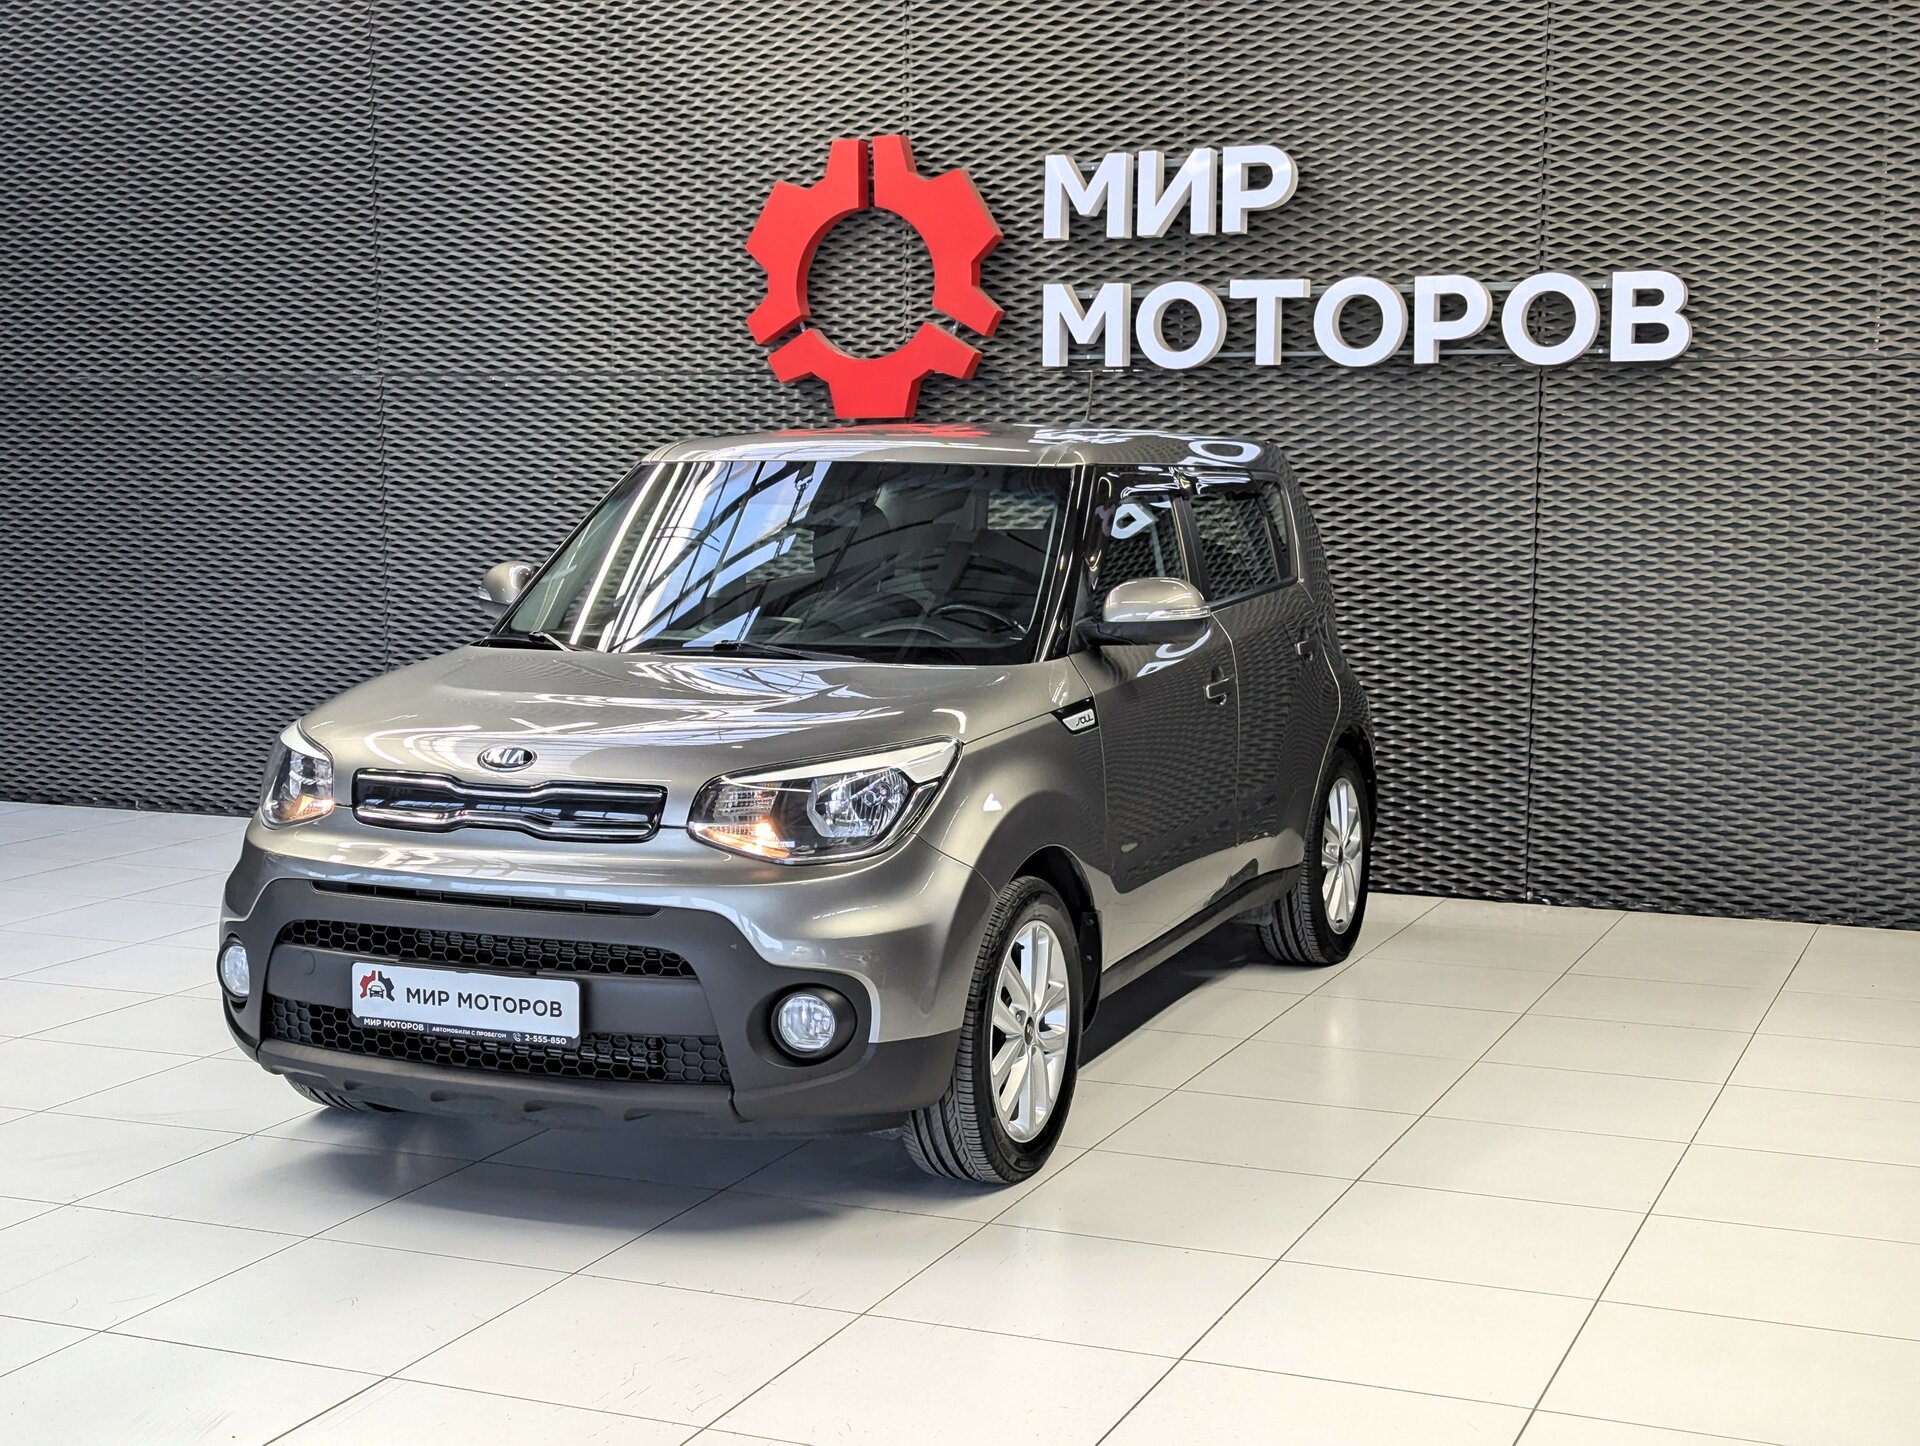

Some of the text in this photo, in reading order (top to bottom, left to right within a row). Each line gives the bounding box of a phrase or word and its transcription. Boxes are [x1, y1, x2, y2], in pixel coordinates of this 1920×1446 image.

[1043, 145, 1299, 239] МИР
[1042, 270, 1692, 369] МОТОРОВ
[485, 747, 525, 765] KIA
[406, 987, 563, 1018] МИР МОТОРОВ
[363, 1018, 382, 1027] МИР
[383, 1020, 425, 1032] МОТОРОВ
[432, 1026, 471, 1036] АВТОМОБИЛИ
[476, 1031, 507, 1039] ПРОБЕГОМ
[524, 1034, 567, 1045] 2-555-850
